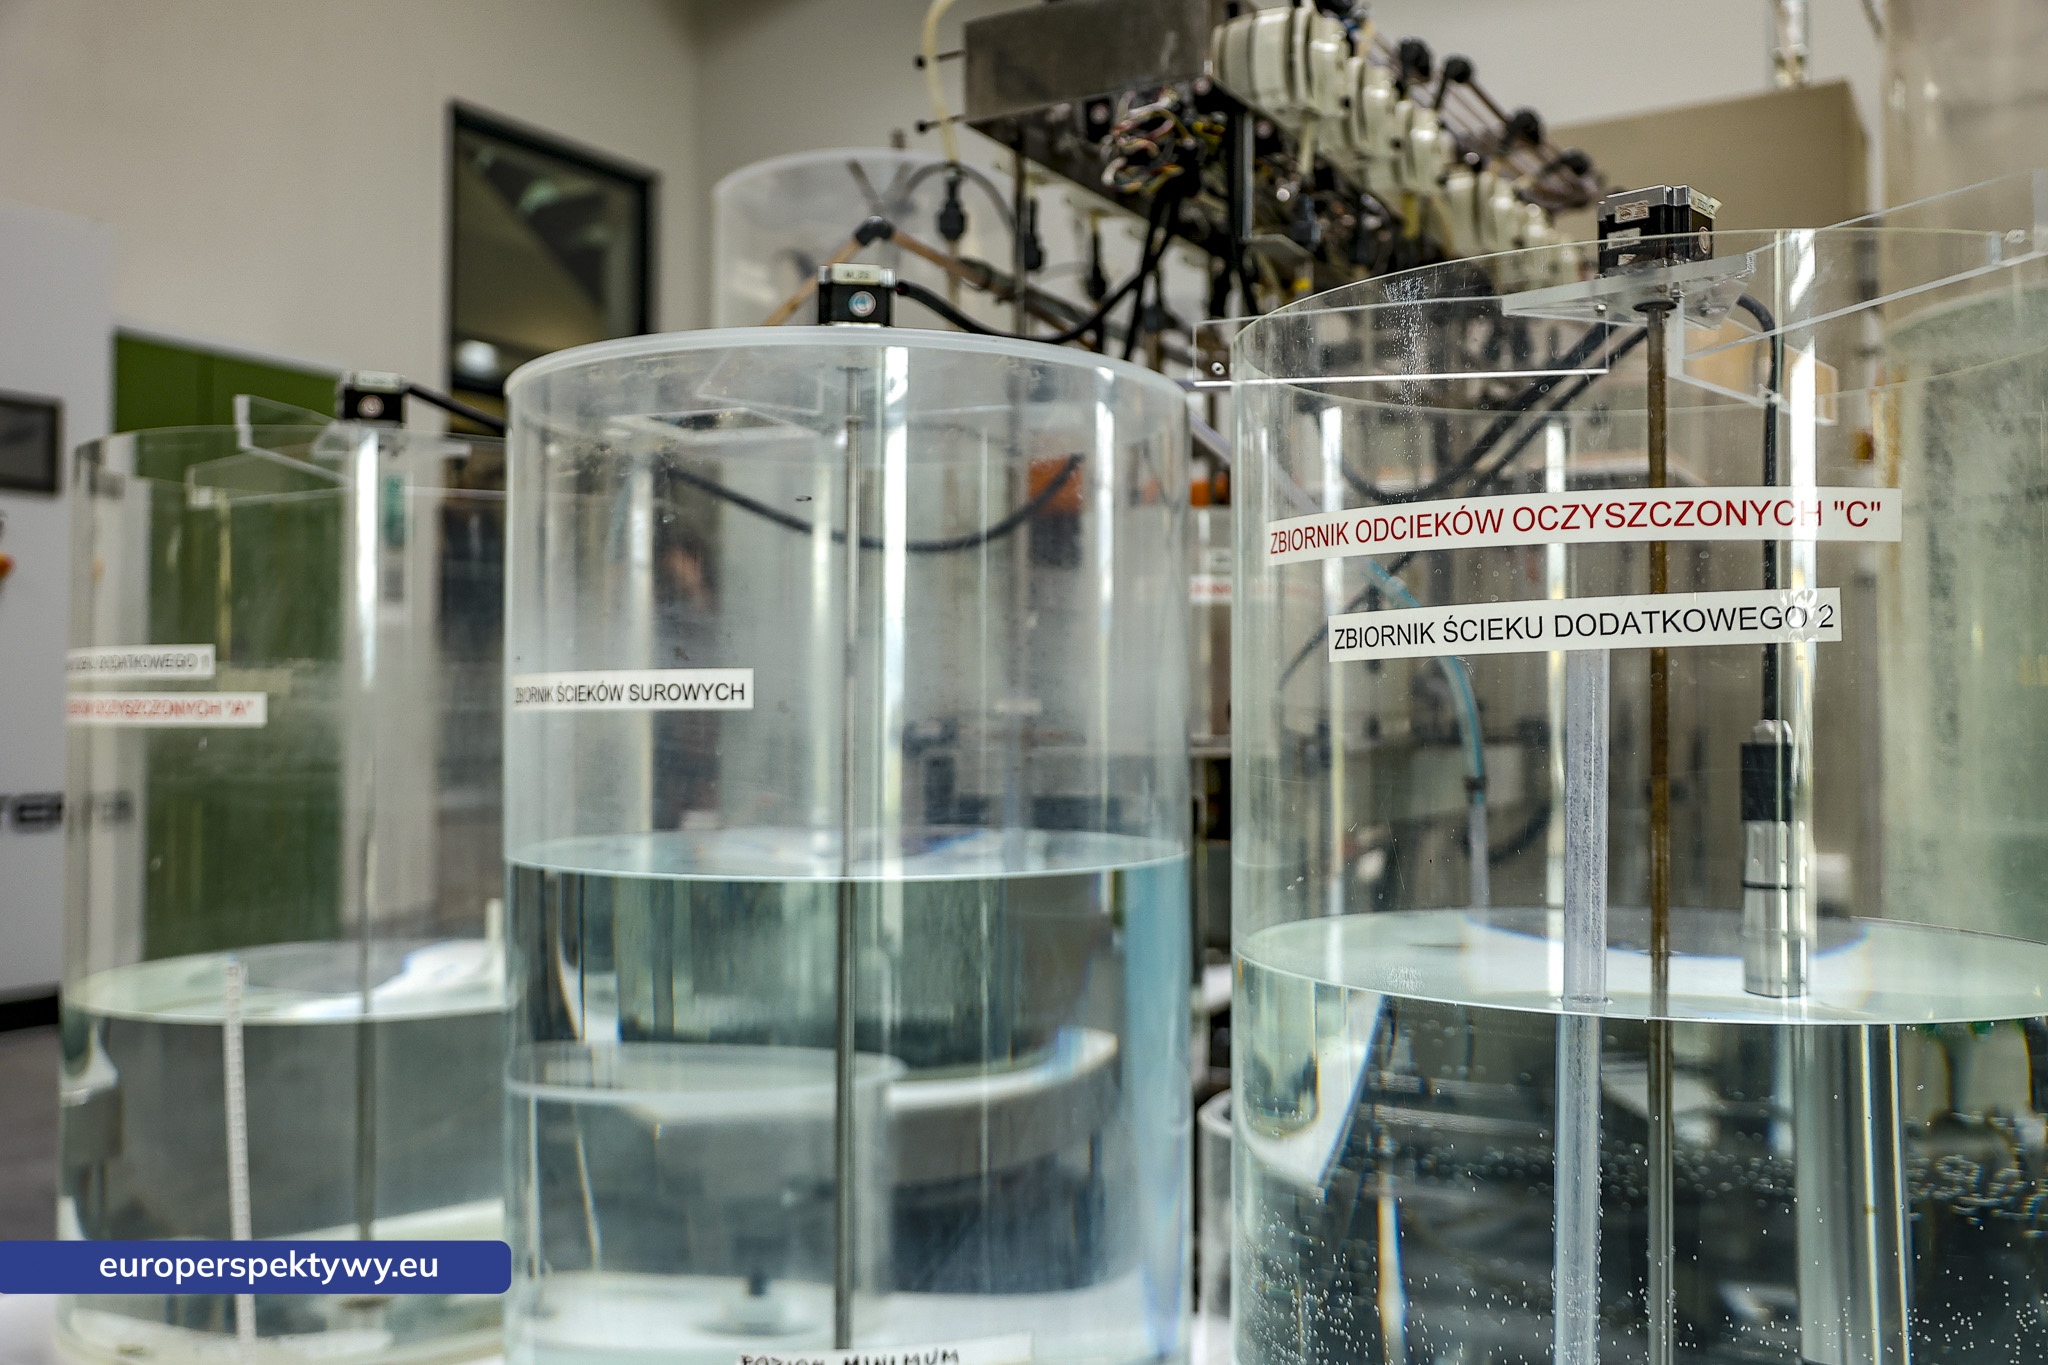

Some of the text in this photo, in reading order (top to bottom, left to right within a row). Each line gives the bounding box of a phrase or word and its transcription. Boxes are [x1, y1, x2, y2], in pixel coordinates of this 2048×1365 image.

[1270, 499, 1881, 554] ZBIORNIK ODCIEKÓW OCZYSZCZONYCH "C"
[1334, 604, 1834, 650] ZBIORNIK ŚCIEKU DODATKOWEGO 2
[557, 680, 624, 702] ŚCIEKÓW
[629, 683, 745, 702] SUROWYCH
